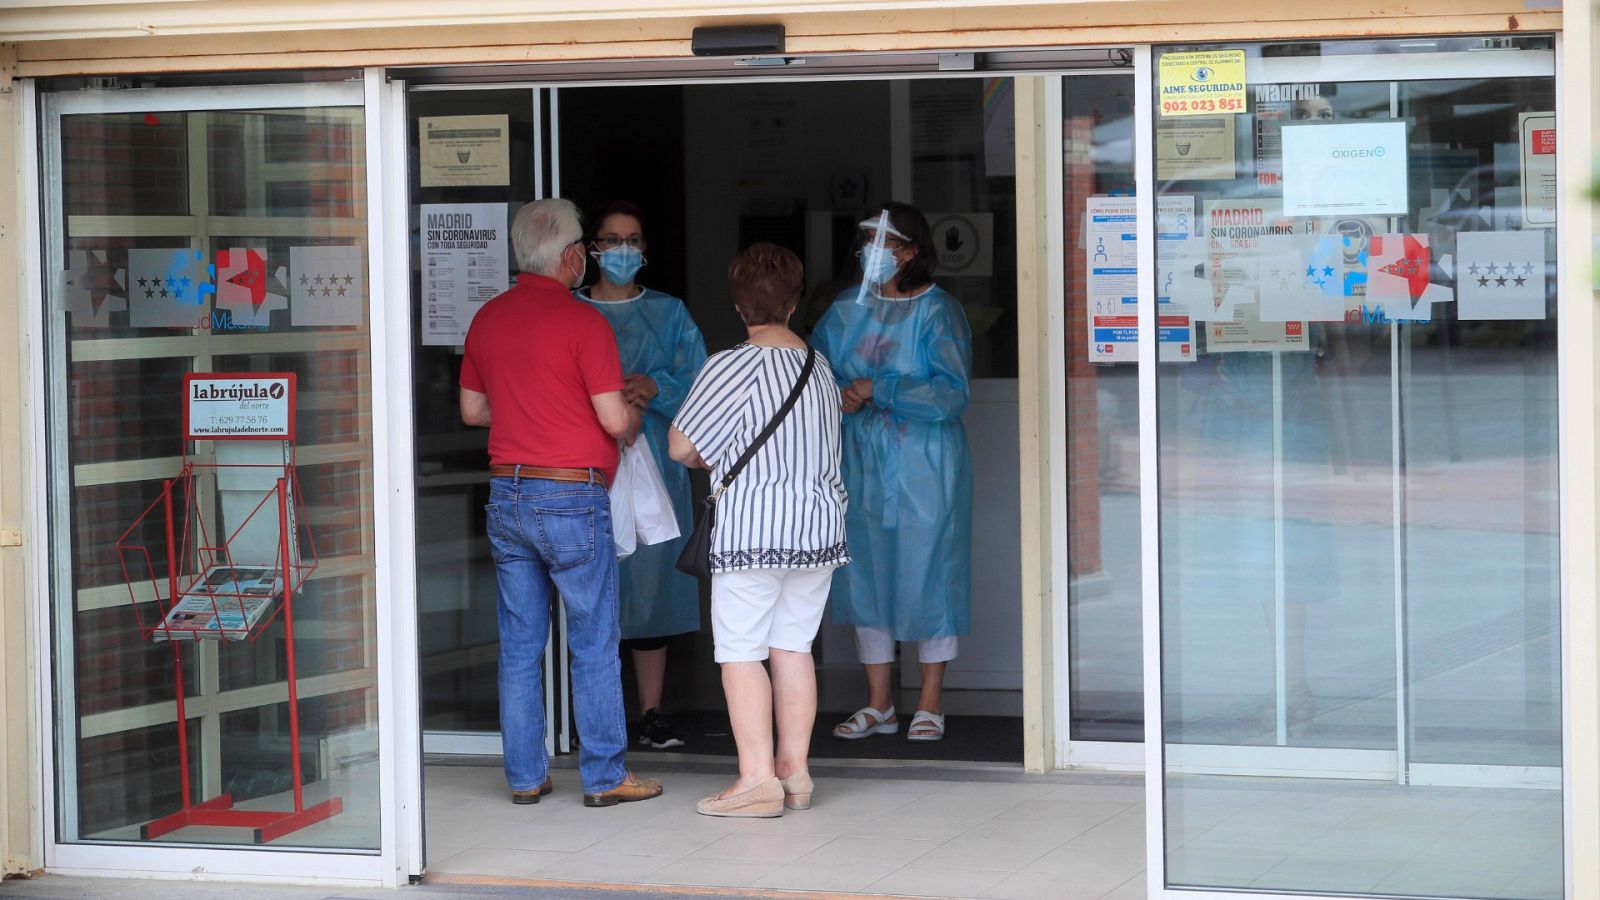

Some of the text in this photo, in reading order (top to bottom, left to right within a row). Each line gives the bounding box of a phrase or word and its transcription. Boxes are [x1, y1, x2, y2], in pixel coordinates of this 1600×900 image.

[1163, 83, 1243, 94] AIME SEGURIDAD
[1163, 98, 1243, 113] 902 023 851
[1332, 146, 1385, 158] OXIGENO
[427, 213, 473, 229] MADRID
[1211, 208, 1264, 226] MADRID
[427, 229, 497, 241] SIN CORONAVIRUS
[1211, 225, 1293, 239] SIN CORONAVIRUS
[427, 240, 488, 249] CON TODA SEGURIDAD
[239, 402, 269, 410] del norte
[218, 416, 234, 424] 629
[246, 415, 257, 423] 56
[258, 415, 268, 423] 76
[193, 426, 284, 434] www.labrujuladelnorte.com
